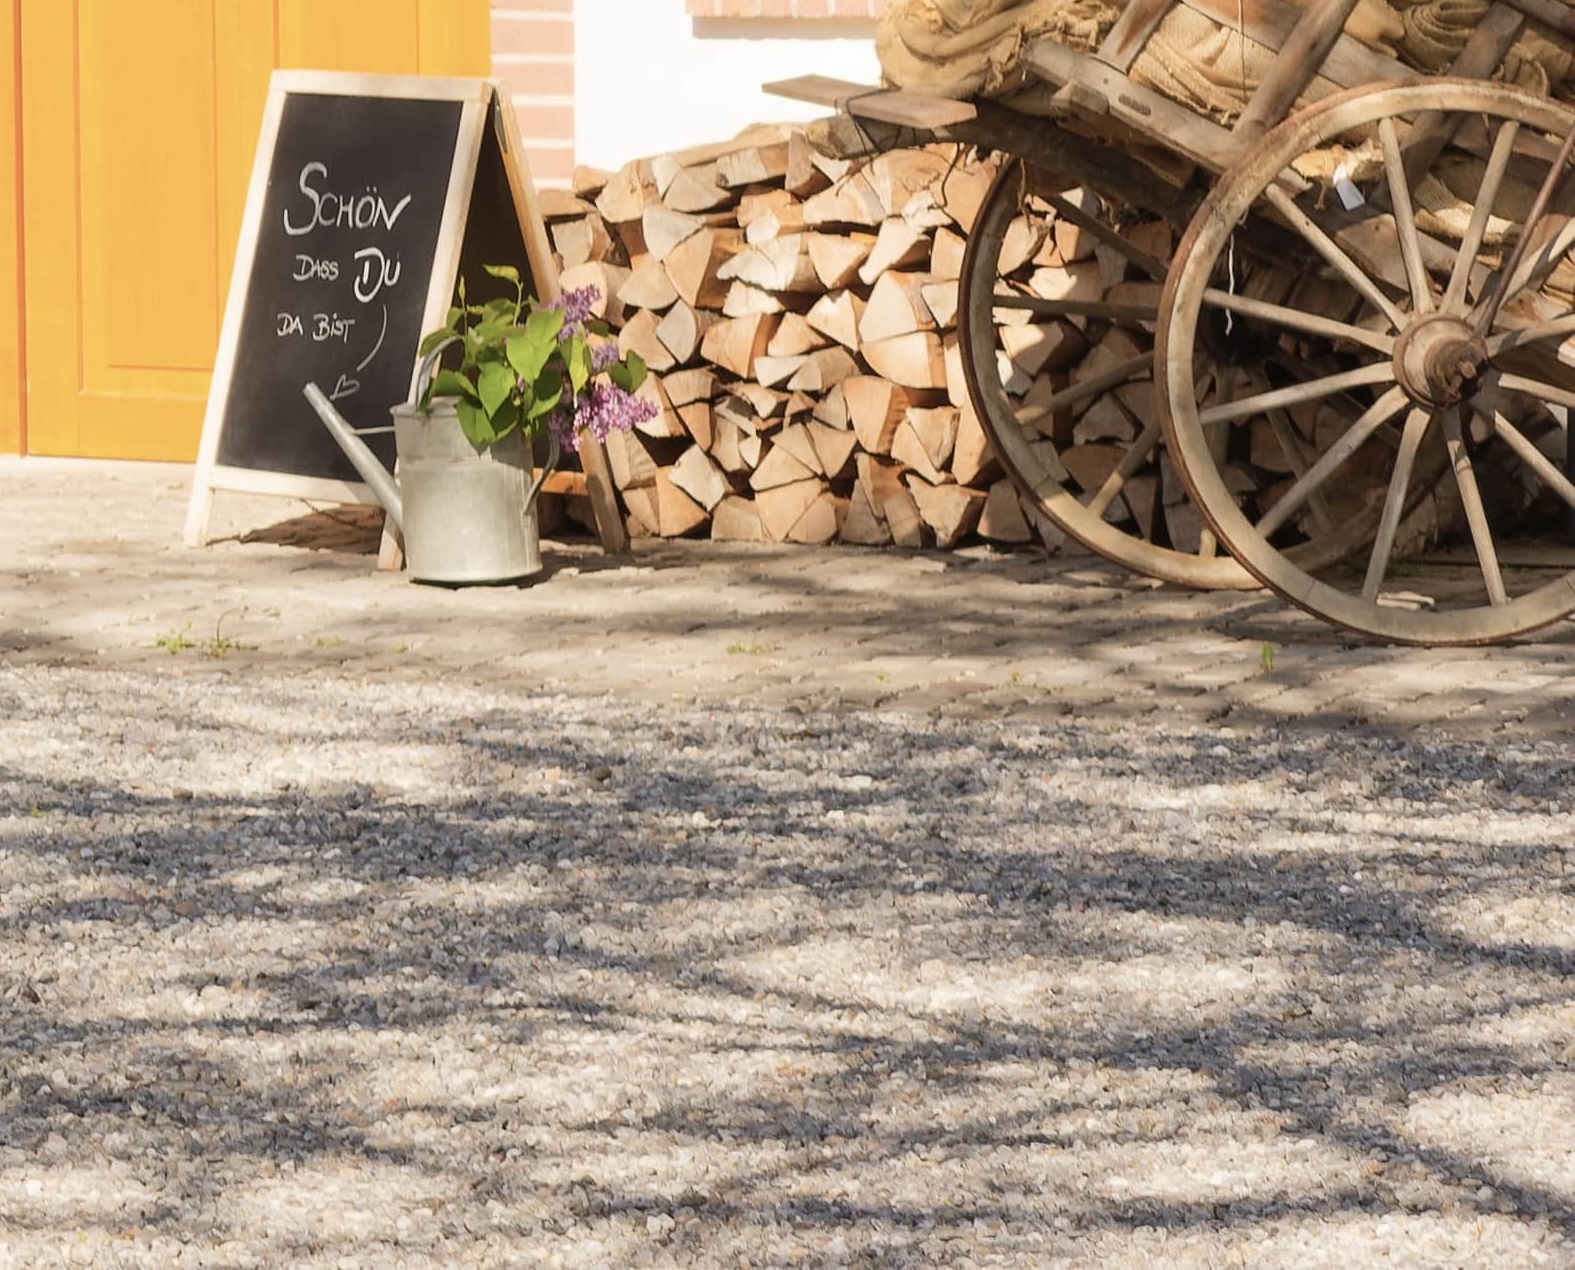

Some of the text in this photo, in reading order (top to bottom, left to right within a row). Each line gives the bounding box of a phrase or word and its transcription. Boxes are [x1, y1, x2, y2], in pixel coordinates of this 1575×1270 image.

[292, 246, 401, 304] DASS DU
[276, 312, 304, 337] DA
